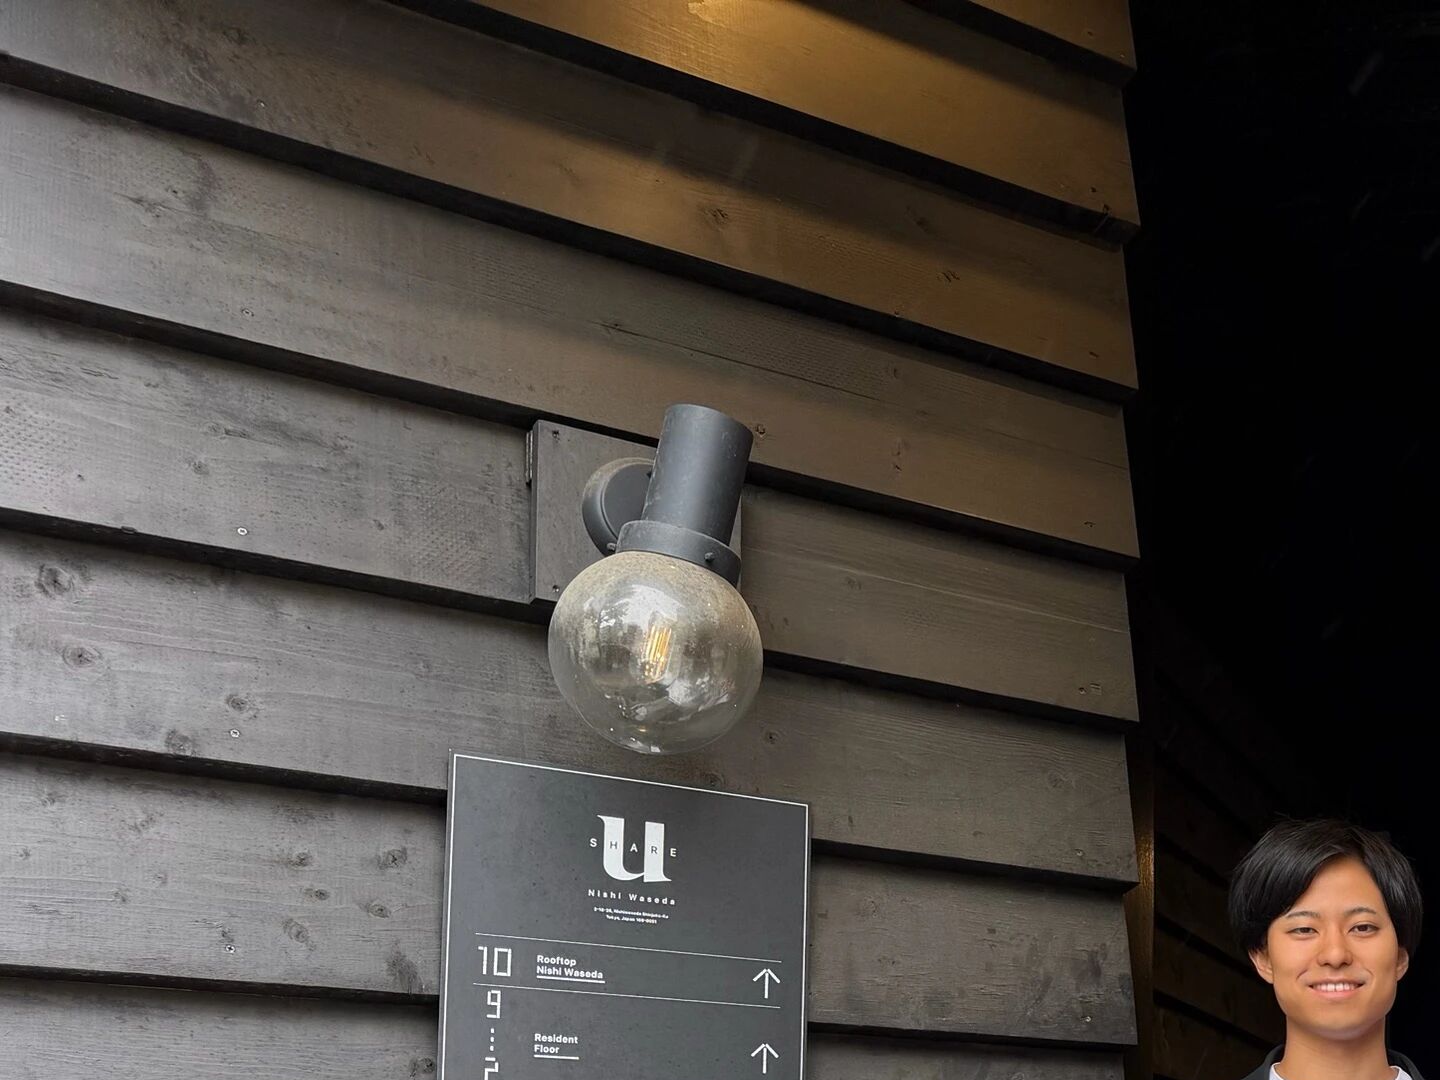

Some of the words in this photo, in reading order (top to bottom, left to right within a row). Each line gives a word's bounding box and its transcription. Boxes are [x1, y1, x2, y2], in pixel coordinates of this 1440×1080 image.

[589, 838, 677, 857] SHARE
[588, 889, 621, 899] Nishi
[629, 894, 675, 905] Waseda
[478, 946, 512, 977] 10
[536, 955, 577, 967] Rooftop
[536, 966, 562, 976] Nishi
[564, 968, 603, 979] Waseda
[486, 990, 501, 1019] 9
[534, 1033, 579, 1044] Resident
[534, 1044, 560, 1054] Floor
